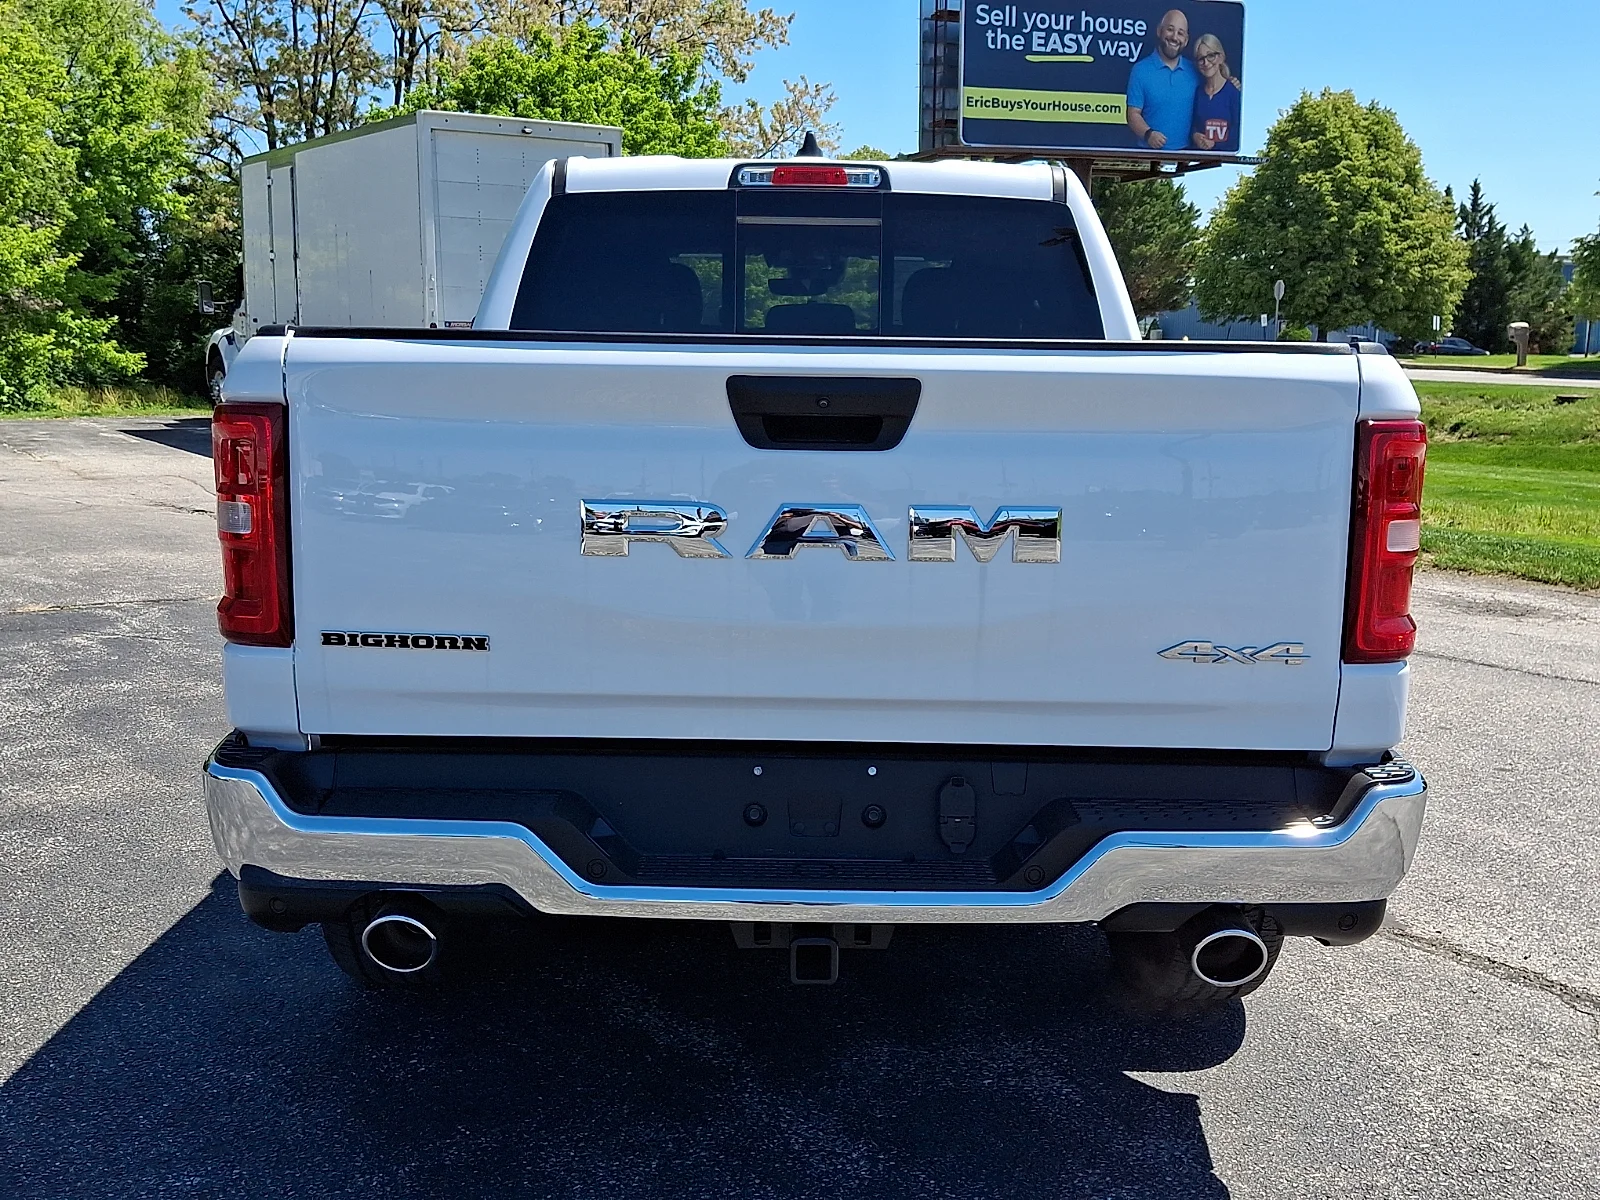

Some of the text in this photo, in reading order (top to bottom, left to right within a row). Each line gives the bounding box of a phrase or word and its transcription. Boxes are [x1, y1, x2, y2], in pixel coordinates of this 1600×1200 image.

[975, 4, 1147, 36] Sell your house
[985, 28, 1143, 62] the EASY way
[966, 96, 1122, 114] EricBuysYourHouse.com
[1206, 126, 1228, 140] TV
[579, 499, 1063, 563] RAM
[321, 630, 490, 651] BIGHORN
